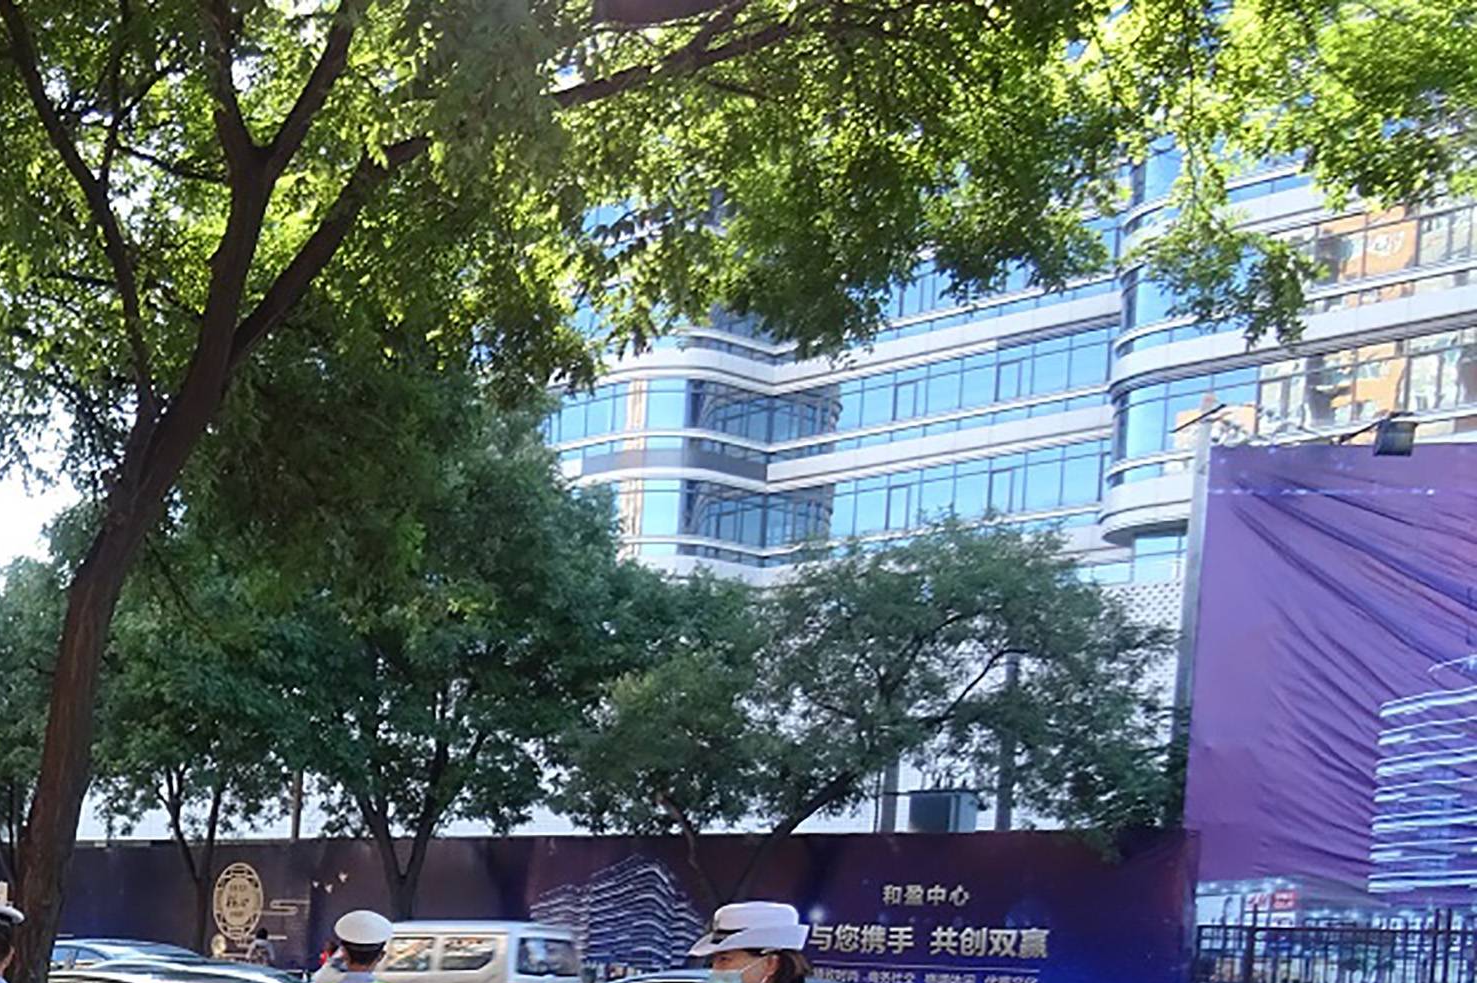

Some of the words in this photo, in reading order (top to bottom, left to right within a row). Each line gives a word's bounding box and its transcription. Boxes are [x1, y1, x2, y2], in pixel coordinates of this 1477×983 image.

[882, 884, 970, 906] 和盈中心
[807, 924, 915, 955] 与您携手
[929, 926, 1051, 959] 共创双赢
